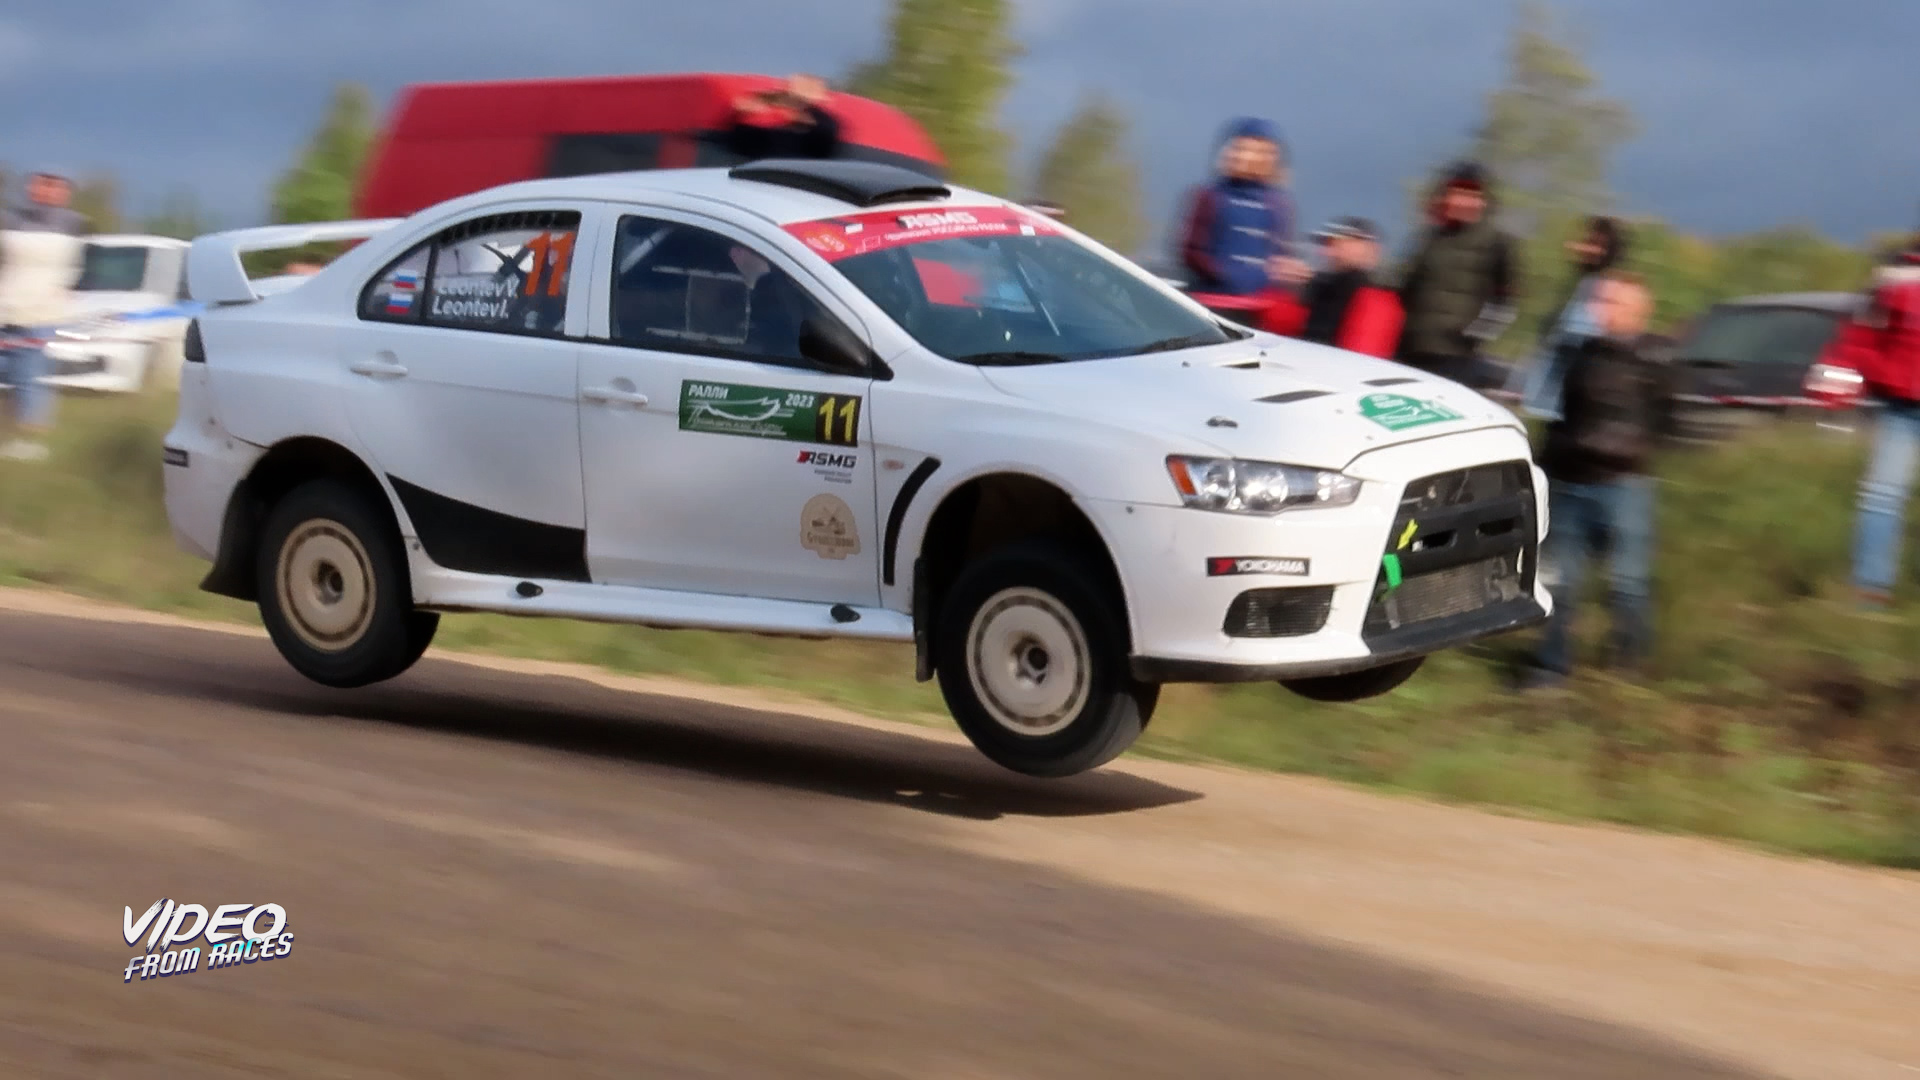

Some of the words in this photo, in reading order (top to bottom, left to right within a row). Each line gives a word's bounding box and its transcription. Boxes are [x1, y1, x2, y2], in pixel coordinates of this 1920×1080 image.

[524, 230, 576, 297] 11
[688, 383, 730, 399] РАЛЛИ
[785, 393, 816, 408] 2023
[819, 396, 857, 442] 11
[1235, 559, 1306, 573] YOKOHAMA
